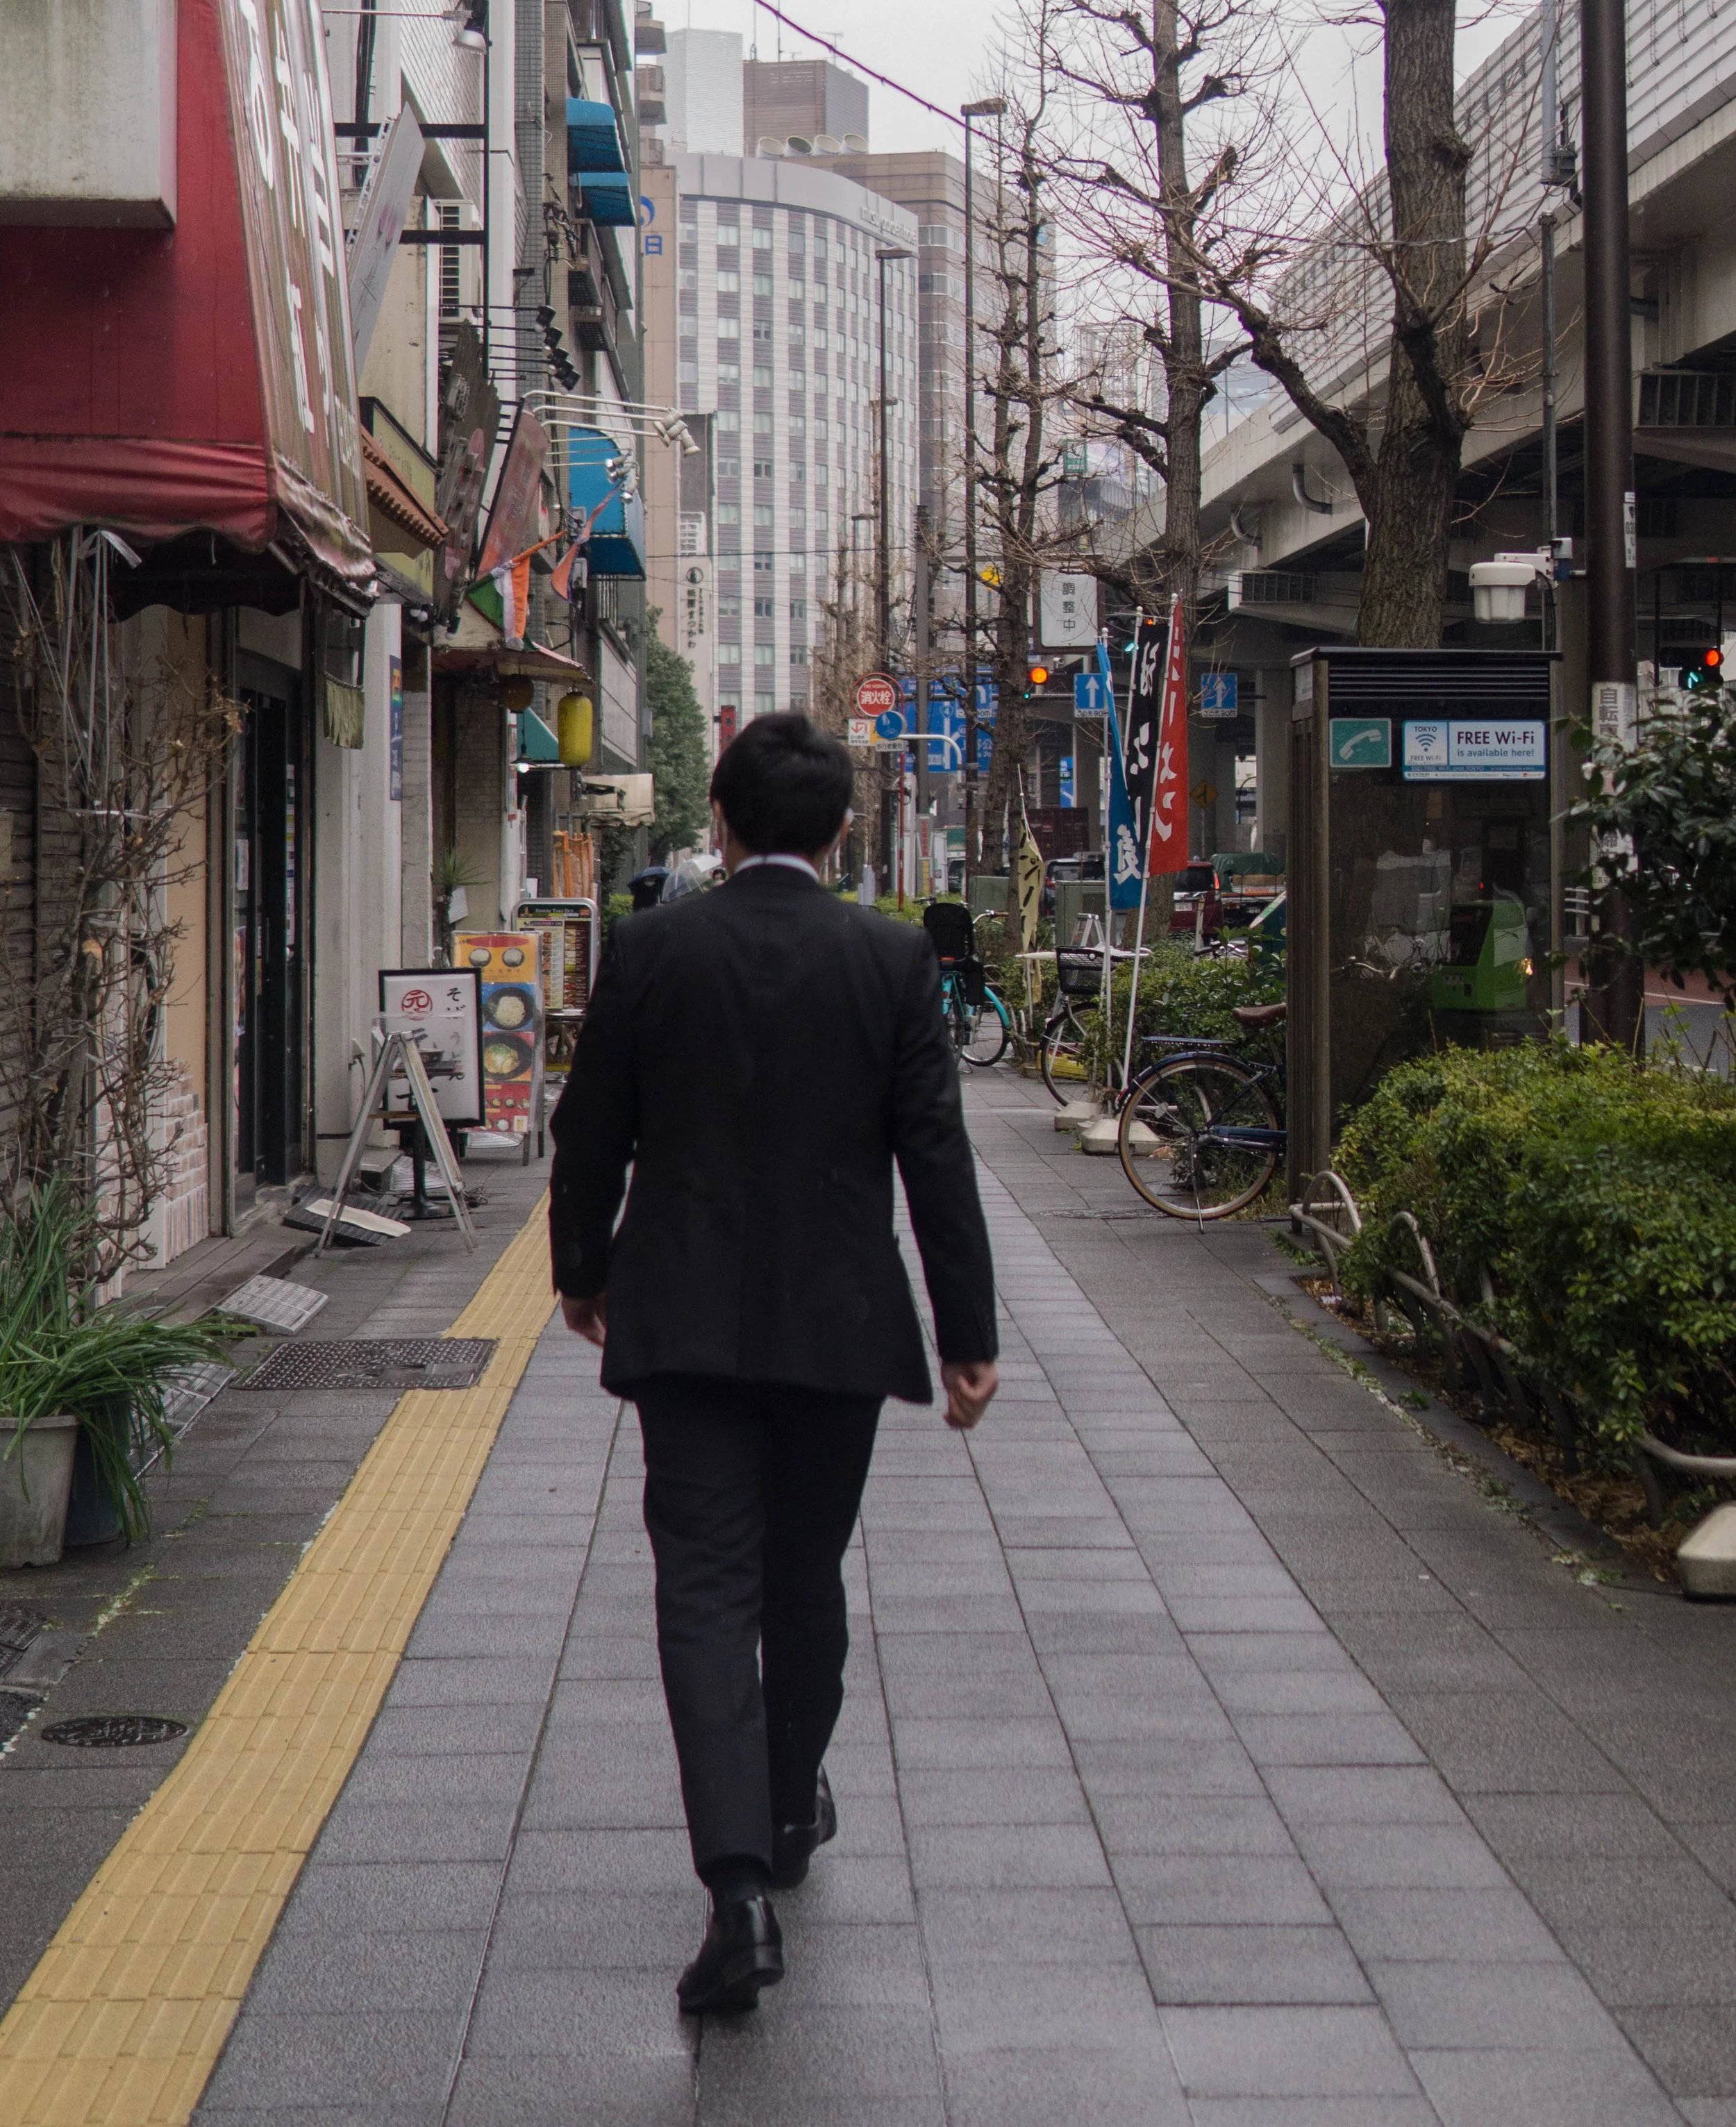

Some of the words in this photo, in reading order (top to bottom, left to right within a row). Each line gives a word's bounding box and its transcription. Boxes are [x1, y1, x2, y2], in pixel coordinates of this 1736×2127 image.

[645, 235, 662, 256] 日
[1062, 583, 1076, 632] 調整中
[860, 690, 892, 705] 消火栓
[1457, 731, 1490, 744] FREE
[1495, 731, 1535, 744] Wi-Fi
[1468, 749, 1508, 757] available
[1512, 749, 1535, 757] here!
